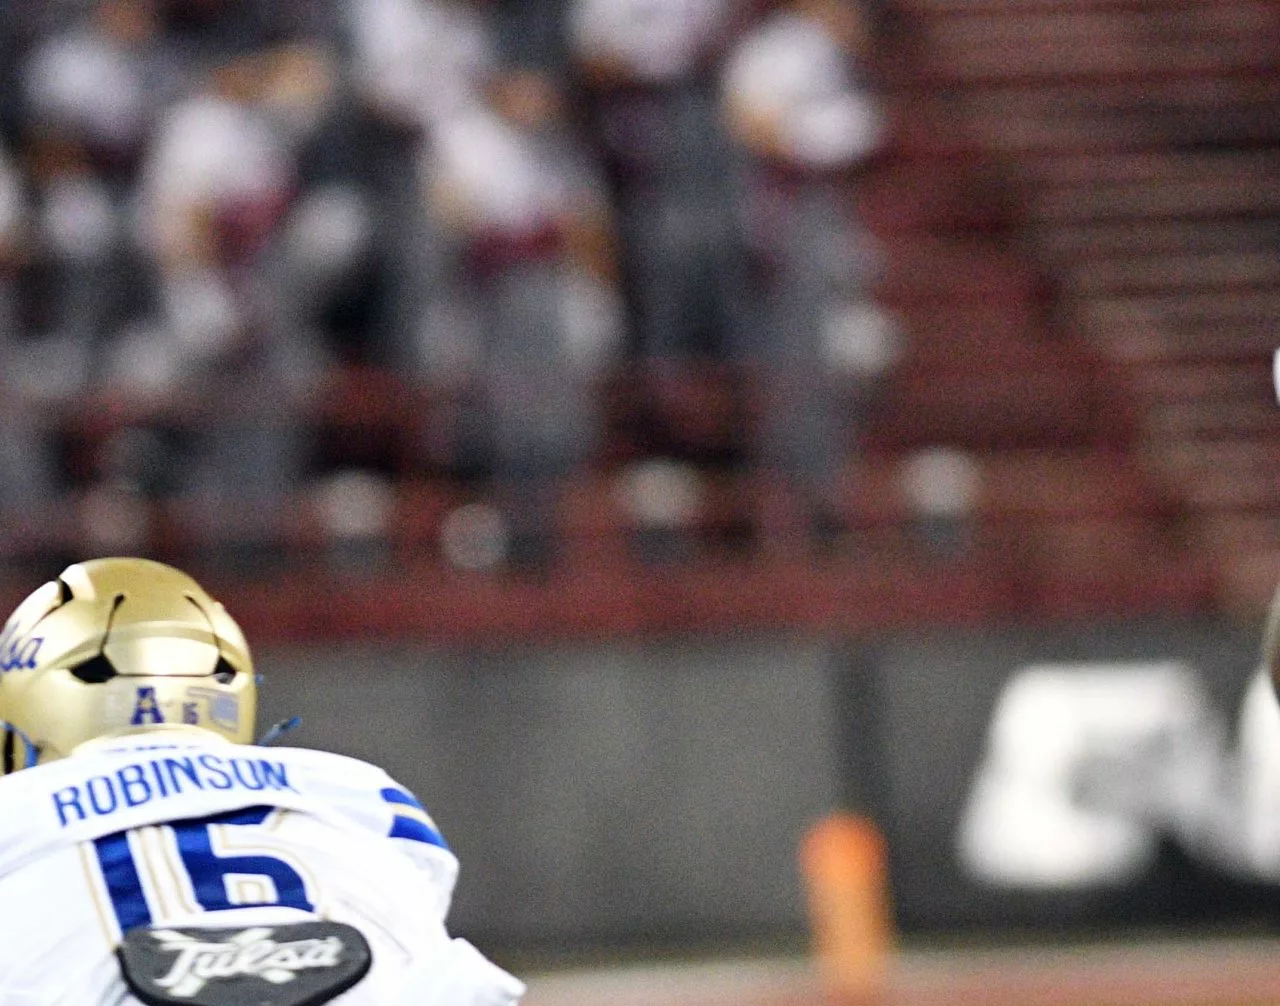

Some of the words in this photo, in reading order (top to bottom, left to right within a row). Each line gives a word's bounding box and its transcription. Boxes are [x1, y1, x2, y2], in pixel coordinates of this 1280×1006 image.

[51, 754, 295, 827] ROBINSON
[88, 806, 320, 938] 16
[152, 933, 343, 992] Tulsa
